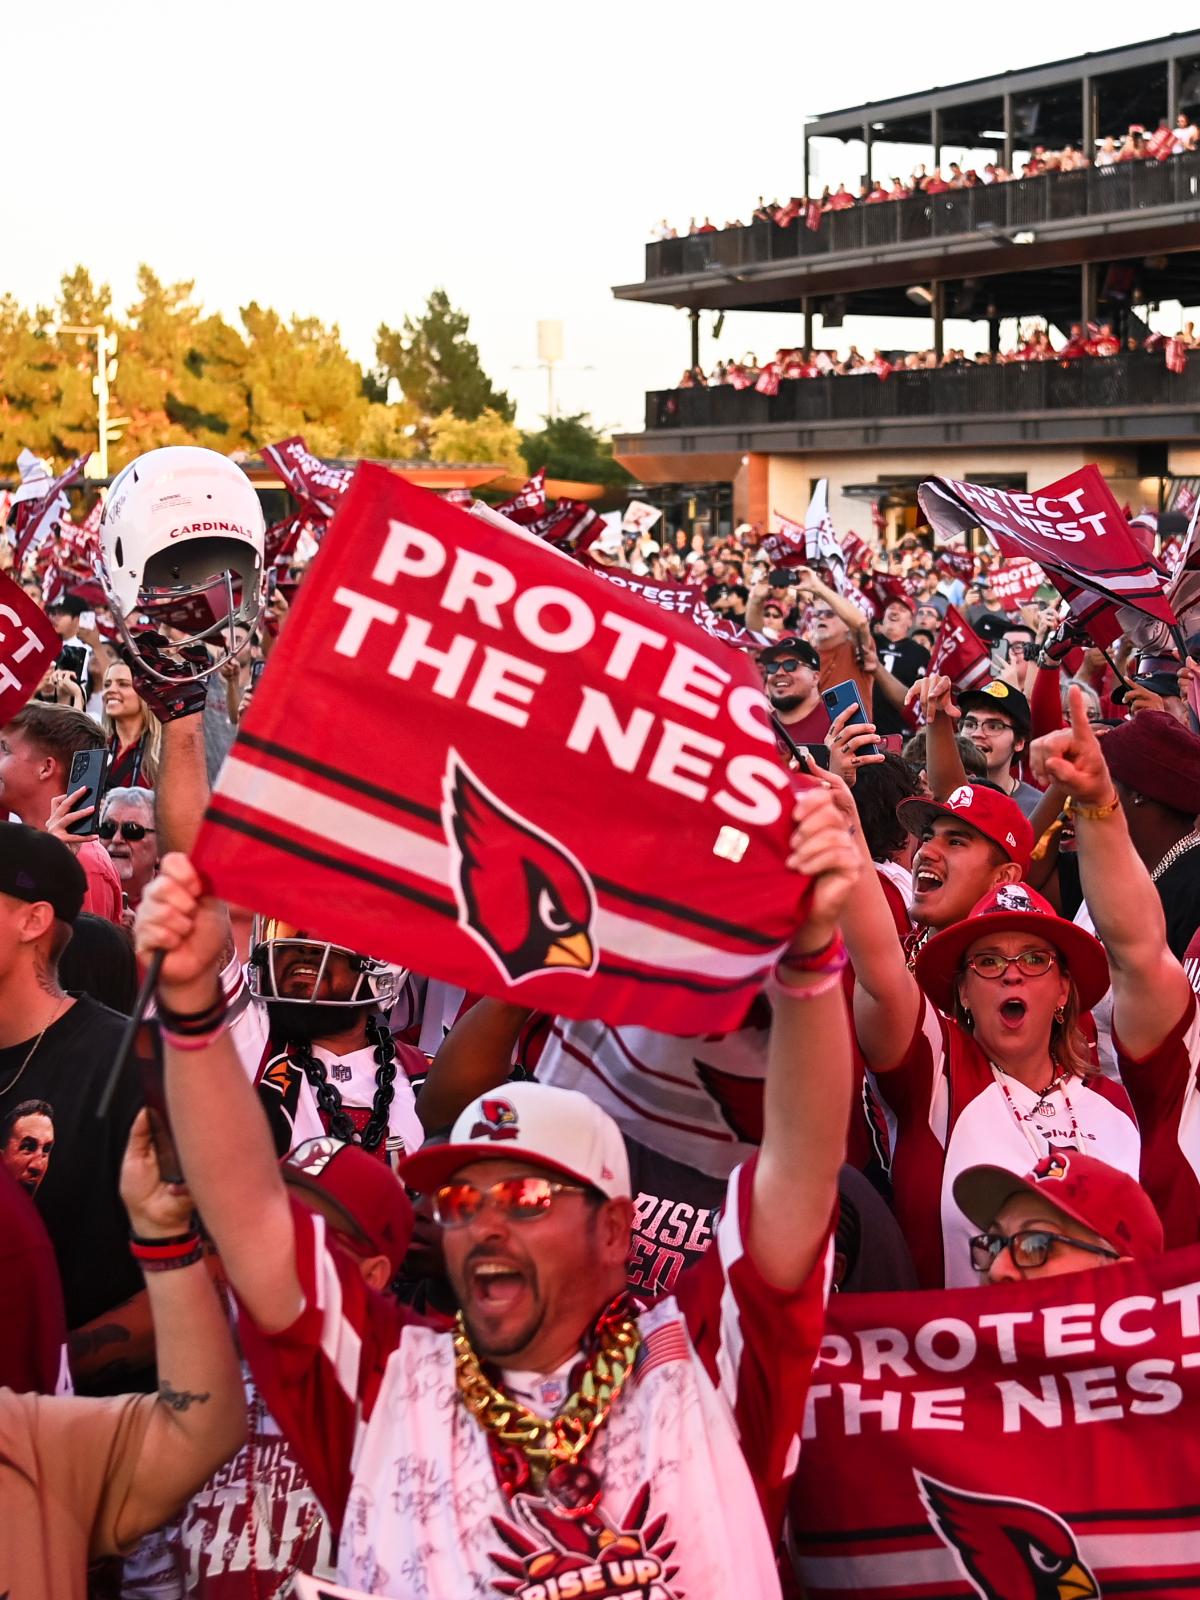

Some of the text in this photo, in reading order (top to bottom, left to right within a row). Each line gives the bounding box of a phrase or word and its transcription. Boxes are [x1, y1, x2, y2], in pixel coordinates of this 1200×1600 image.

[170, 521, 253, 539] CARDINALS
[1006, 508, 1107, 543] NEST
[588, 566, 693, 601] ROTECT
[371, 518, 777, 746] PROTEC
[332, 586, 791, 826] THE NES
[631, 1191, 712, 1252] RISE
[626, 1234, 686, 1292] ED
[801, 1382, 966, 1440] THE
[517, 1564, 606, 1600] RISE
[607, 1557, 661, 1587] UP
